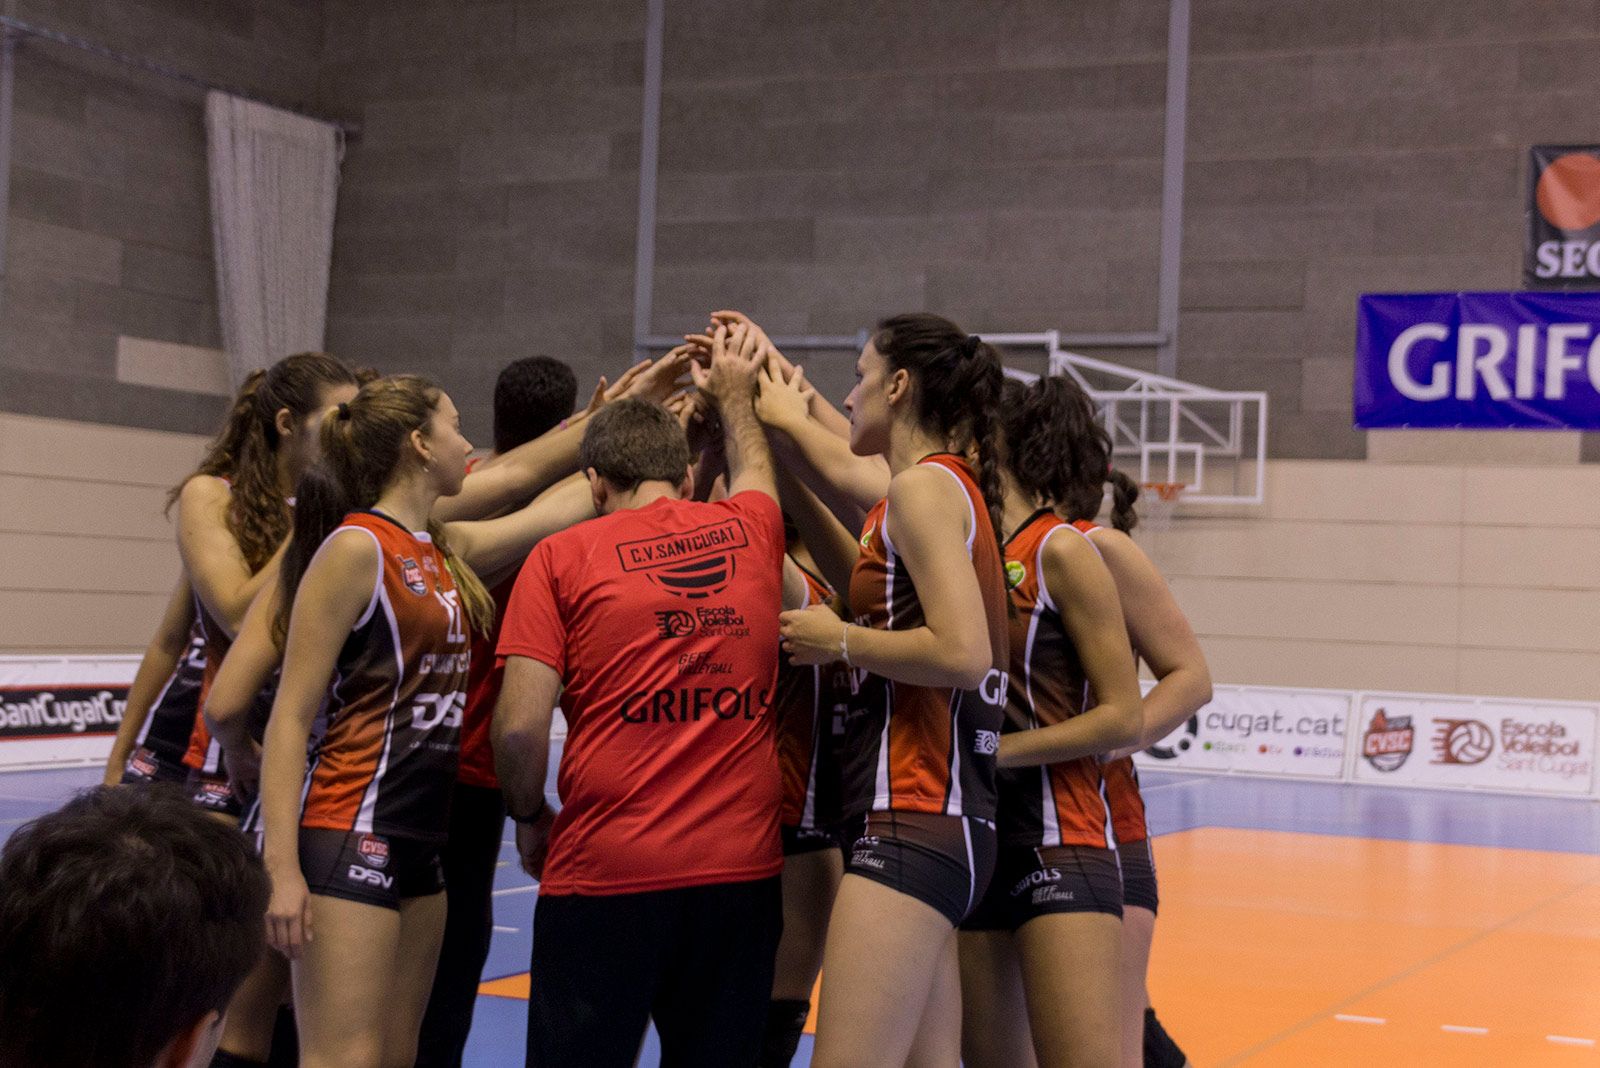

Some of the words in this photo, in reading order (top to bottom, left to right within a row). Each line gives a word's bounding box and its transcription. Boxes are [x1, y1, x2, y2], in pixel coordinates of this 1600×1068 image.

[1387, 322, 1600, 402] GRIF
[696, 605, 735, 618] Escola
[1205, 710, 1344, 738] cugat.cat
[1501, 718, 1566, 737] Escola
[1501, 736, 1579, 756] Voleibol
[348, 864, 393, 890] DSV
